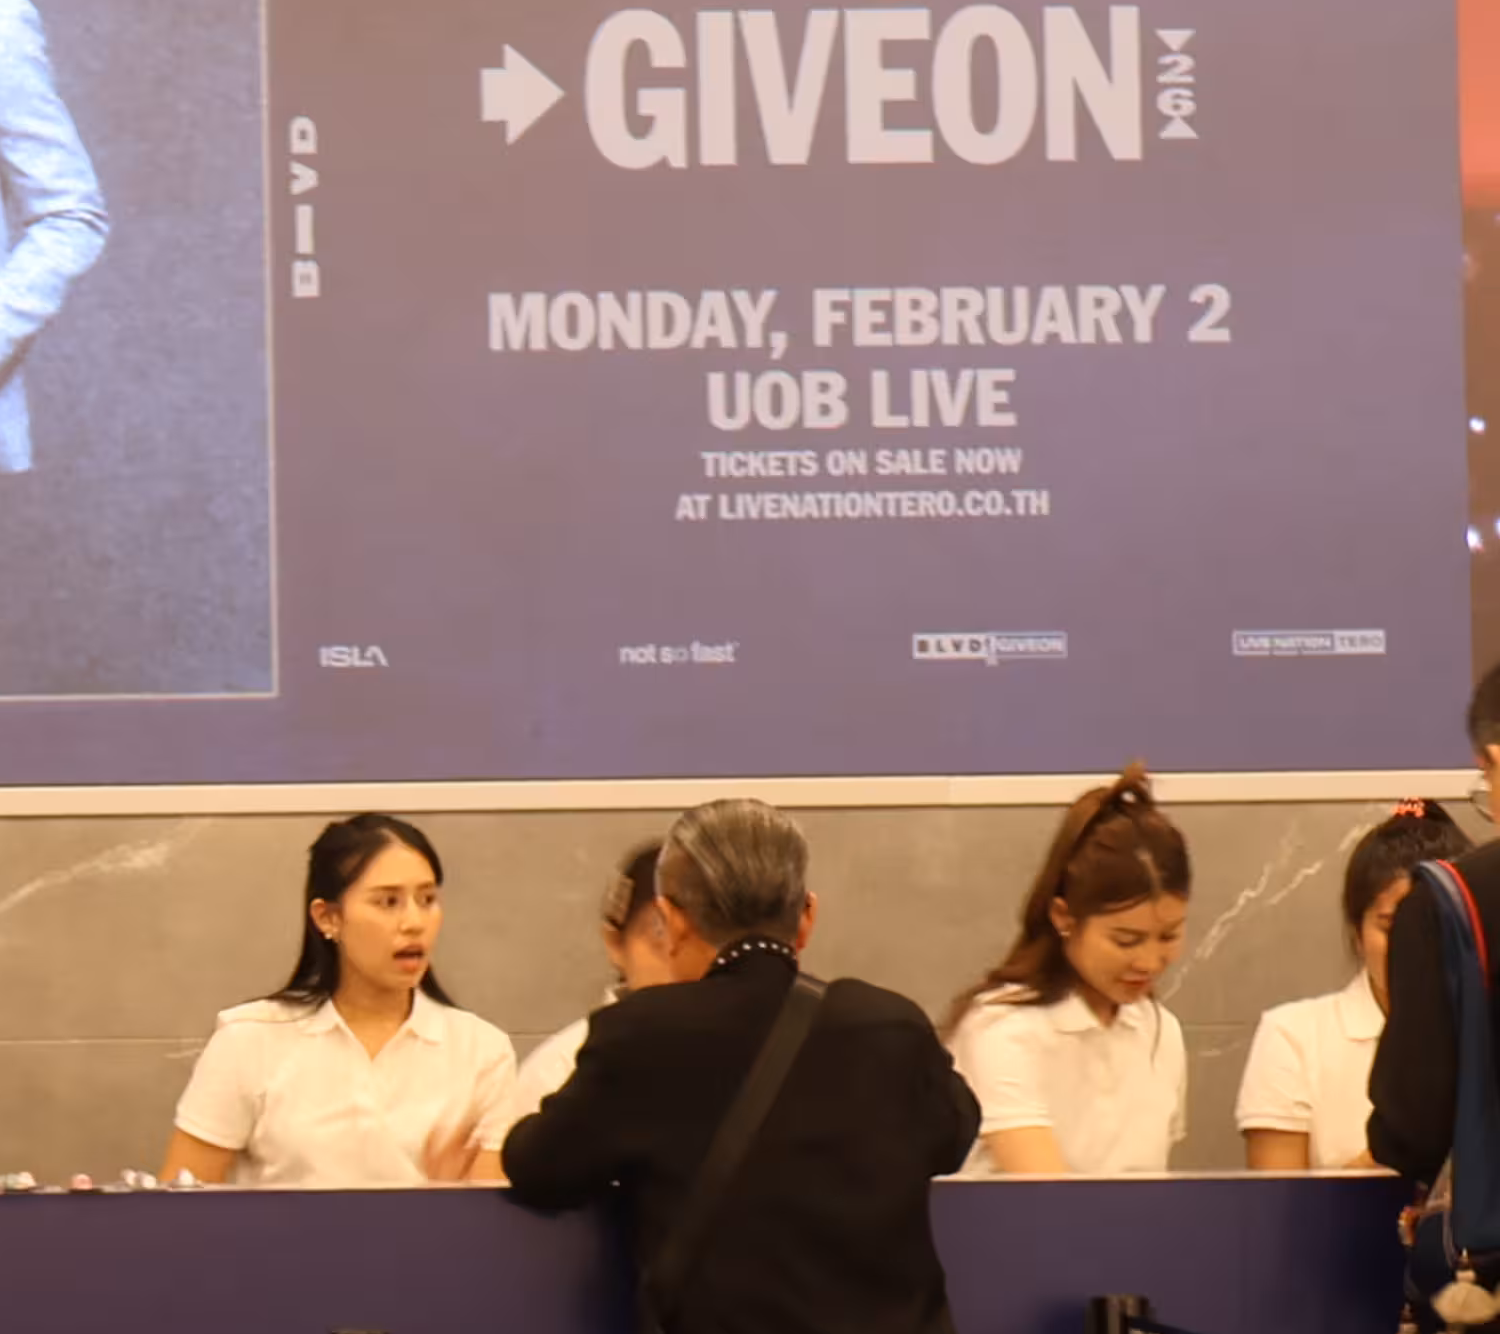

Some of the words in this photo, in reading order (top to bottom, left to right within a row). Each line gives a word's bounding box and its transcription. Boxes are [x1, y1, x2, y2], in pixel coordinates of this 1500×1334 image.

[487, 291, 787, 359] MONDAY,
[813, 286, 1166, 346] FEBRUARY
[1188, 284, 1231, 342] 2
[707, 371, 848, 430] UOB
[872, 369, 1017, 427] LIVE
[701, 450, 818, 476] TICKETS
[826, 450, 867, 475] ON
[875, 449, 946, 475] SALE
[954, 448, 1022, 474] NOW
[675, 493, 709, 519] AT
[719, 490, 1049, 518] LIVENATIONTERO.CO.TH
[319, 645, 389, 667] ISLA
[619, 643, 657, 664] not
[660, 646, 688, 664] so
